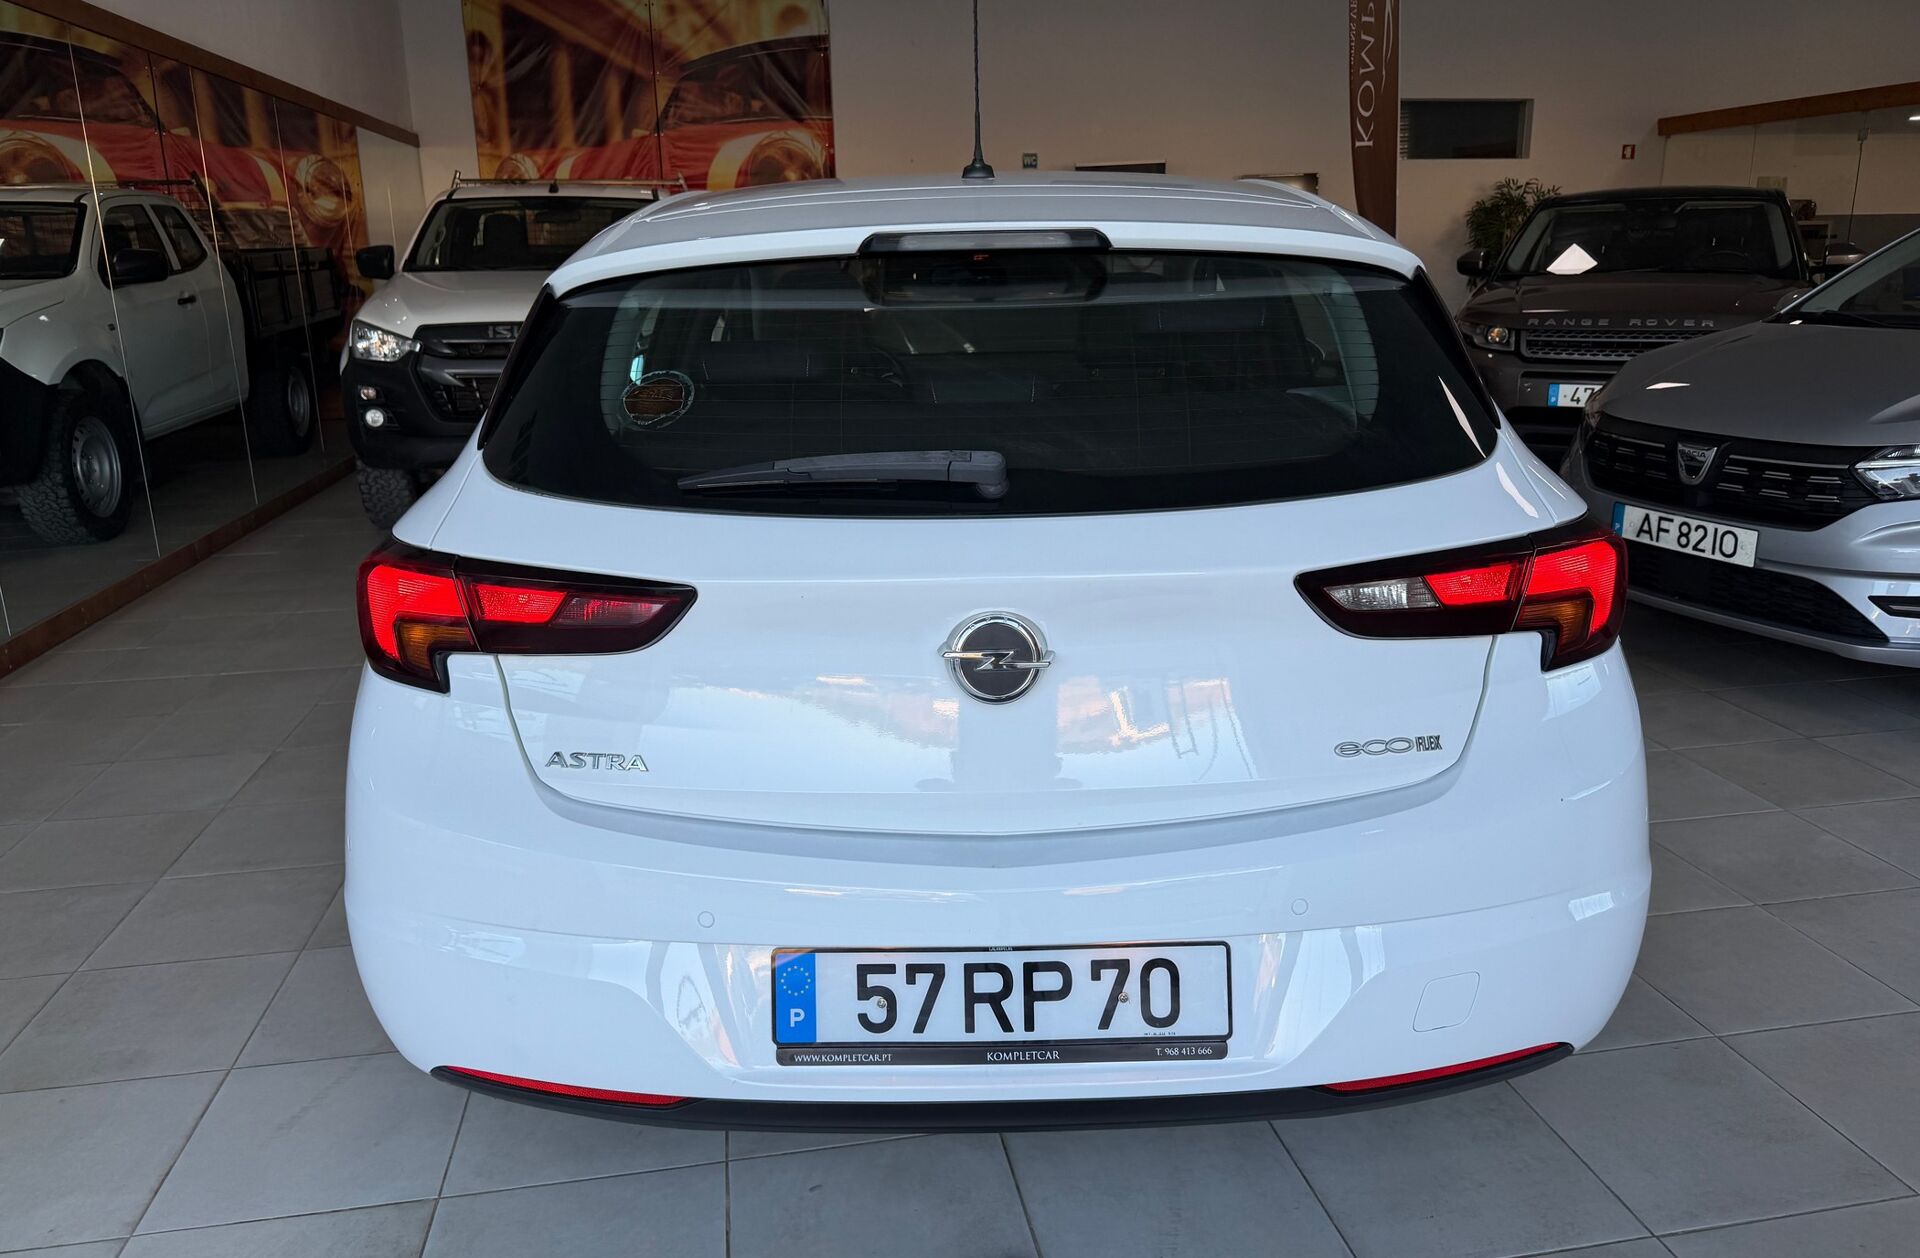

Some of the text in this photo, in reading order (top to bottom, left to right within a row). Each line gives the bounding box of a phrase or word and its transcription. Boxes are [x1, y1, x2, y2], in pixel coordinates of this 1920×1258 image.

[1527, 318, 1715, 327] RANGE ROVER
[545, 751, 649, 772] ASTRA
[790, 1008, 805, 1027] P
[986, 1050, 1060, 1061] KOMPLETCAR
[1164, 1047, 1180, 1056] 968
[1181, 1047, 1196, 1056] 413
[1197, 1046, 1213, 1055] 666
[793, 1053, 893, 1062] WWW.KOMPLETCAR.PT
